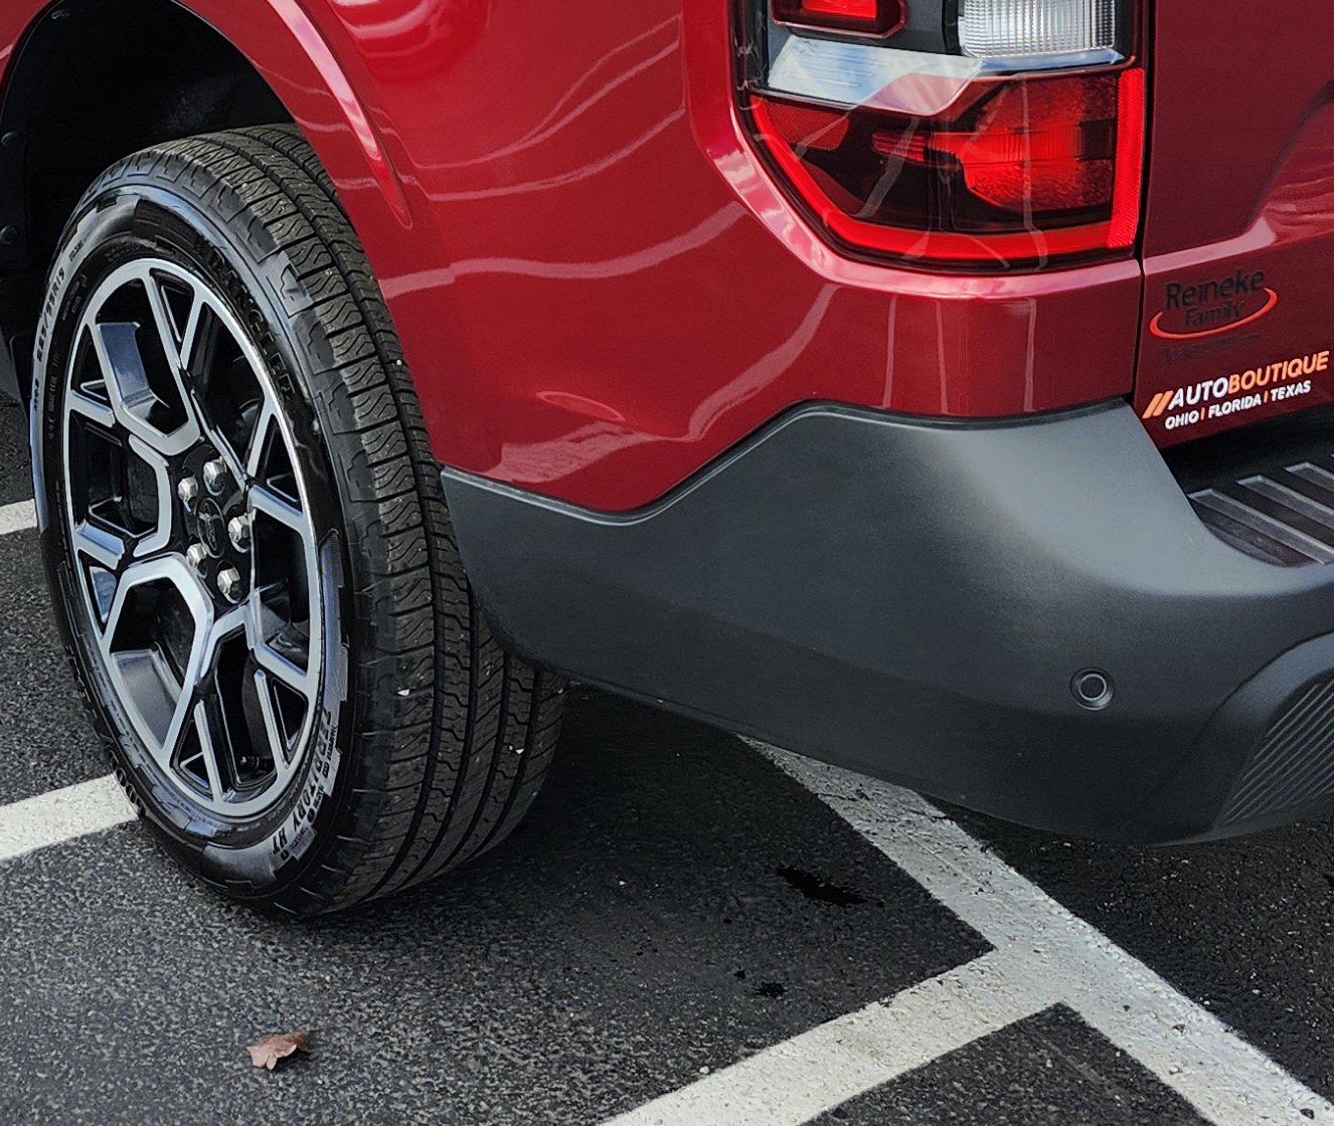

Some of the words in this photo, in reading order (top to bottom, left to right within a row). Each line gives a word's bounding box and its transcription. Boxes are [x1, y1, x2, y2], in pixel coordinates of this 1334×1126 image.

[1164, 266, 1265, 310] Reineke
[1165, 410, 1200, 430] OHIO
[1207, 393, 1262, 419] FLORIDA
[1270, 380, 1312, 402] TEXAS
[1166, 349, 1330, 411] AUTOBOUTIQUE
